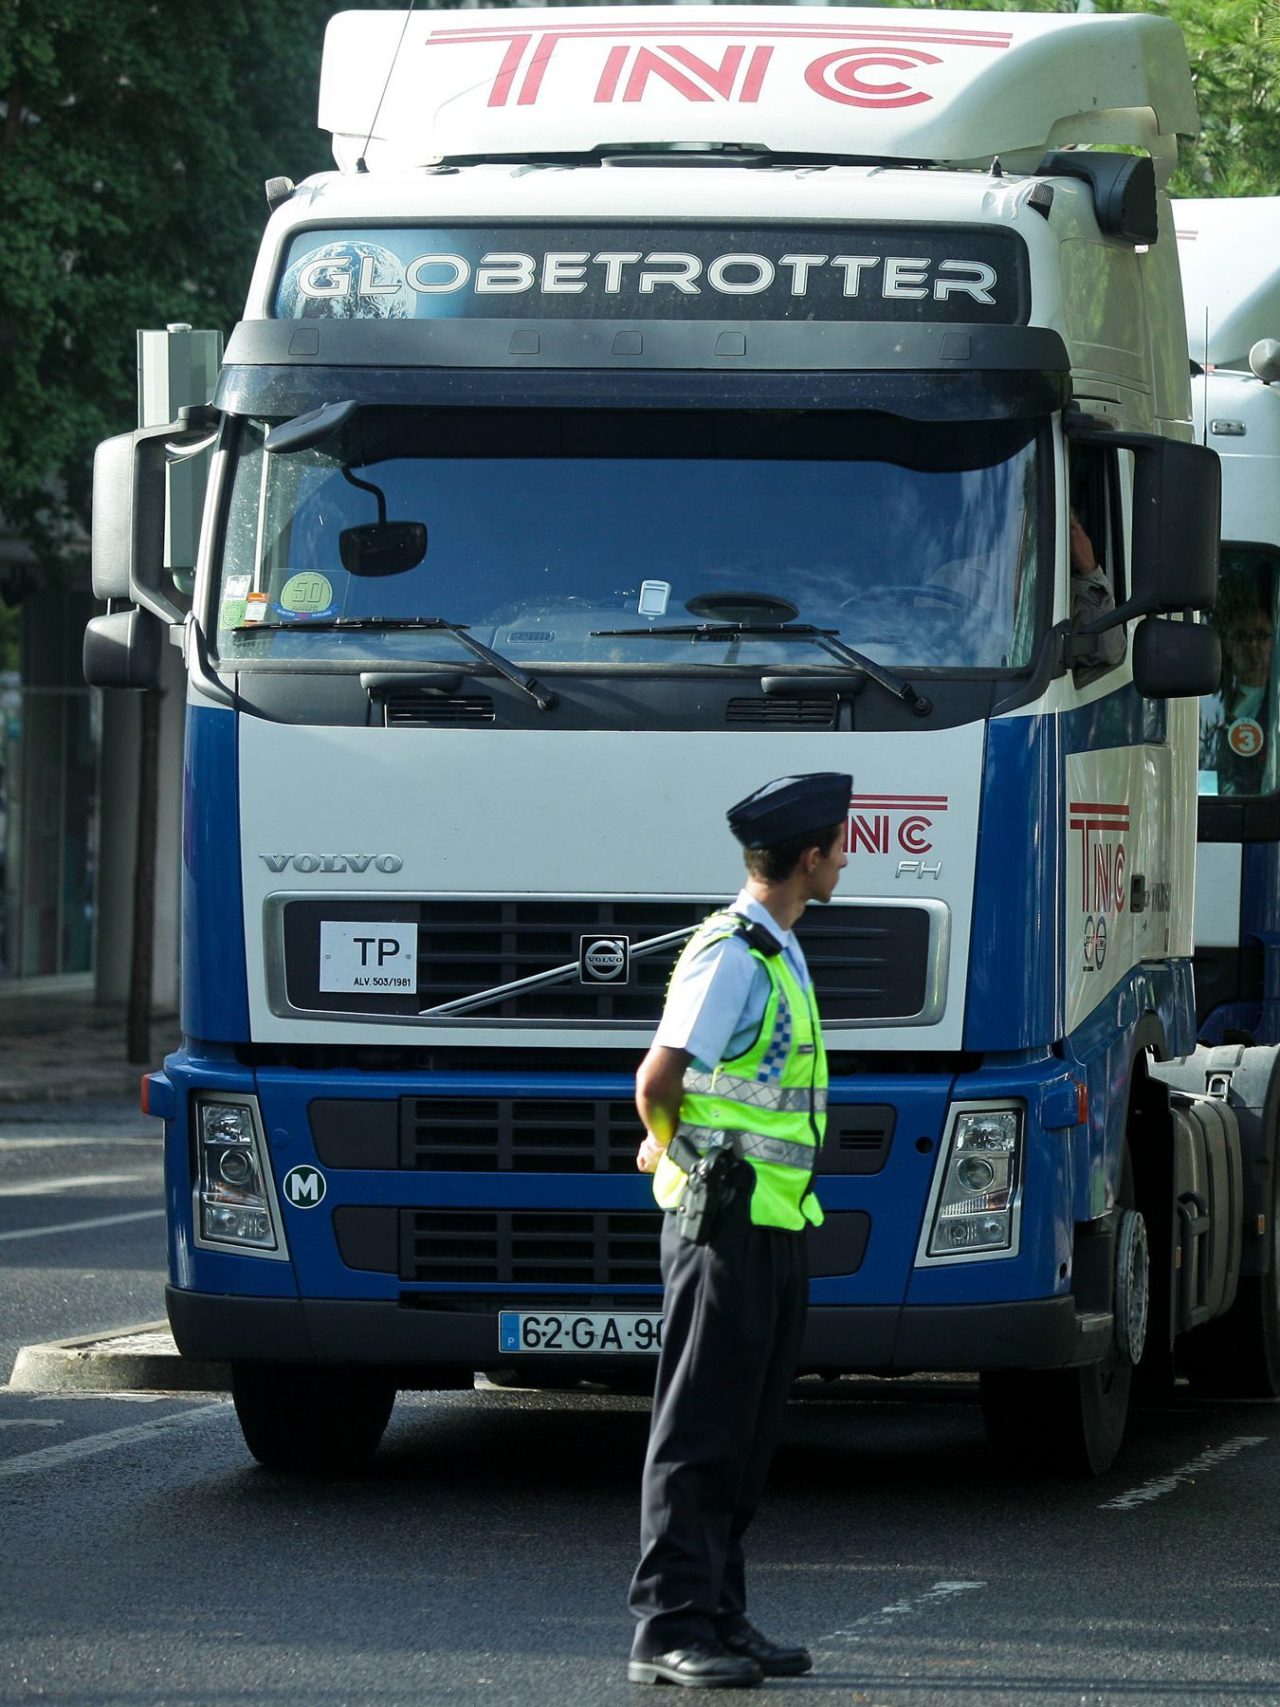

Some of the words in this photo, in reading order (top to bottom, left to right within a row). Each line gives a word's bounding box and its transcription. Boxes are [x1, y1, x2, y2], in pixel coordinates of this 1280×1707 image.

[425, 22, 1012, 109] TNC
[297, 251, 998, 305] GLOBETROTTER
[1238, 731, 1256, 751] 3
[842, 803, 947, 855] NC
[258, 852, 403, 874] VOLVO
[895, 861, 942, 880] FH
[1070, 803, 1129, 912] TNC
[353, 938, 400, 966] TP
[353, 978, 371, 986] ALV.
[373, 978, 411, 987] 503/1981
[291, 1173, 319, 1201] M
[507, 1337, 515, 1346] P
